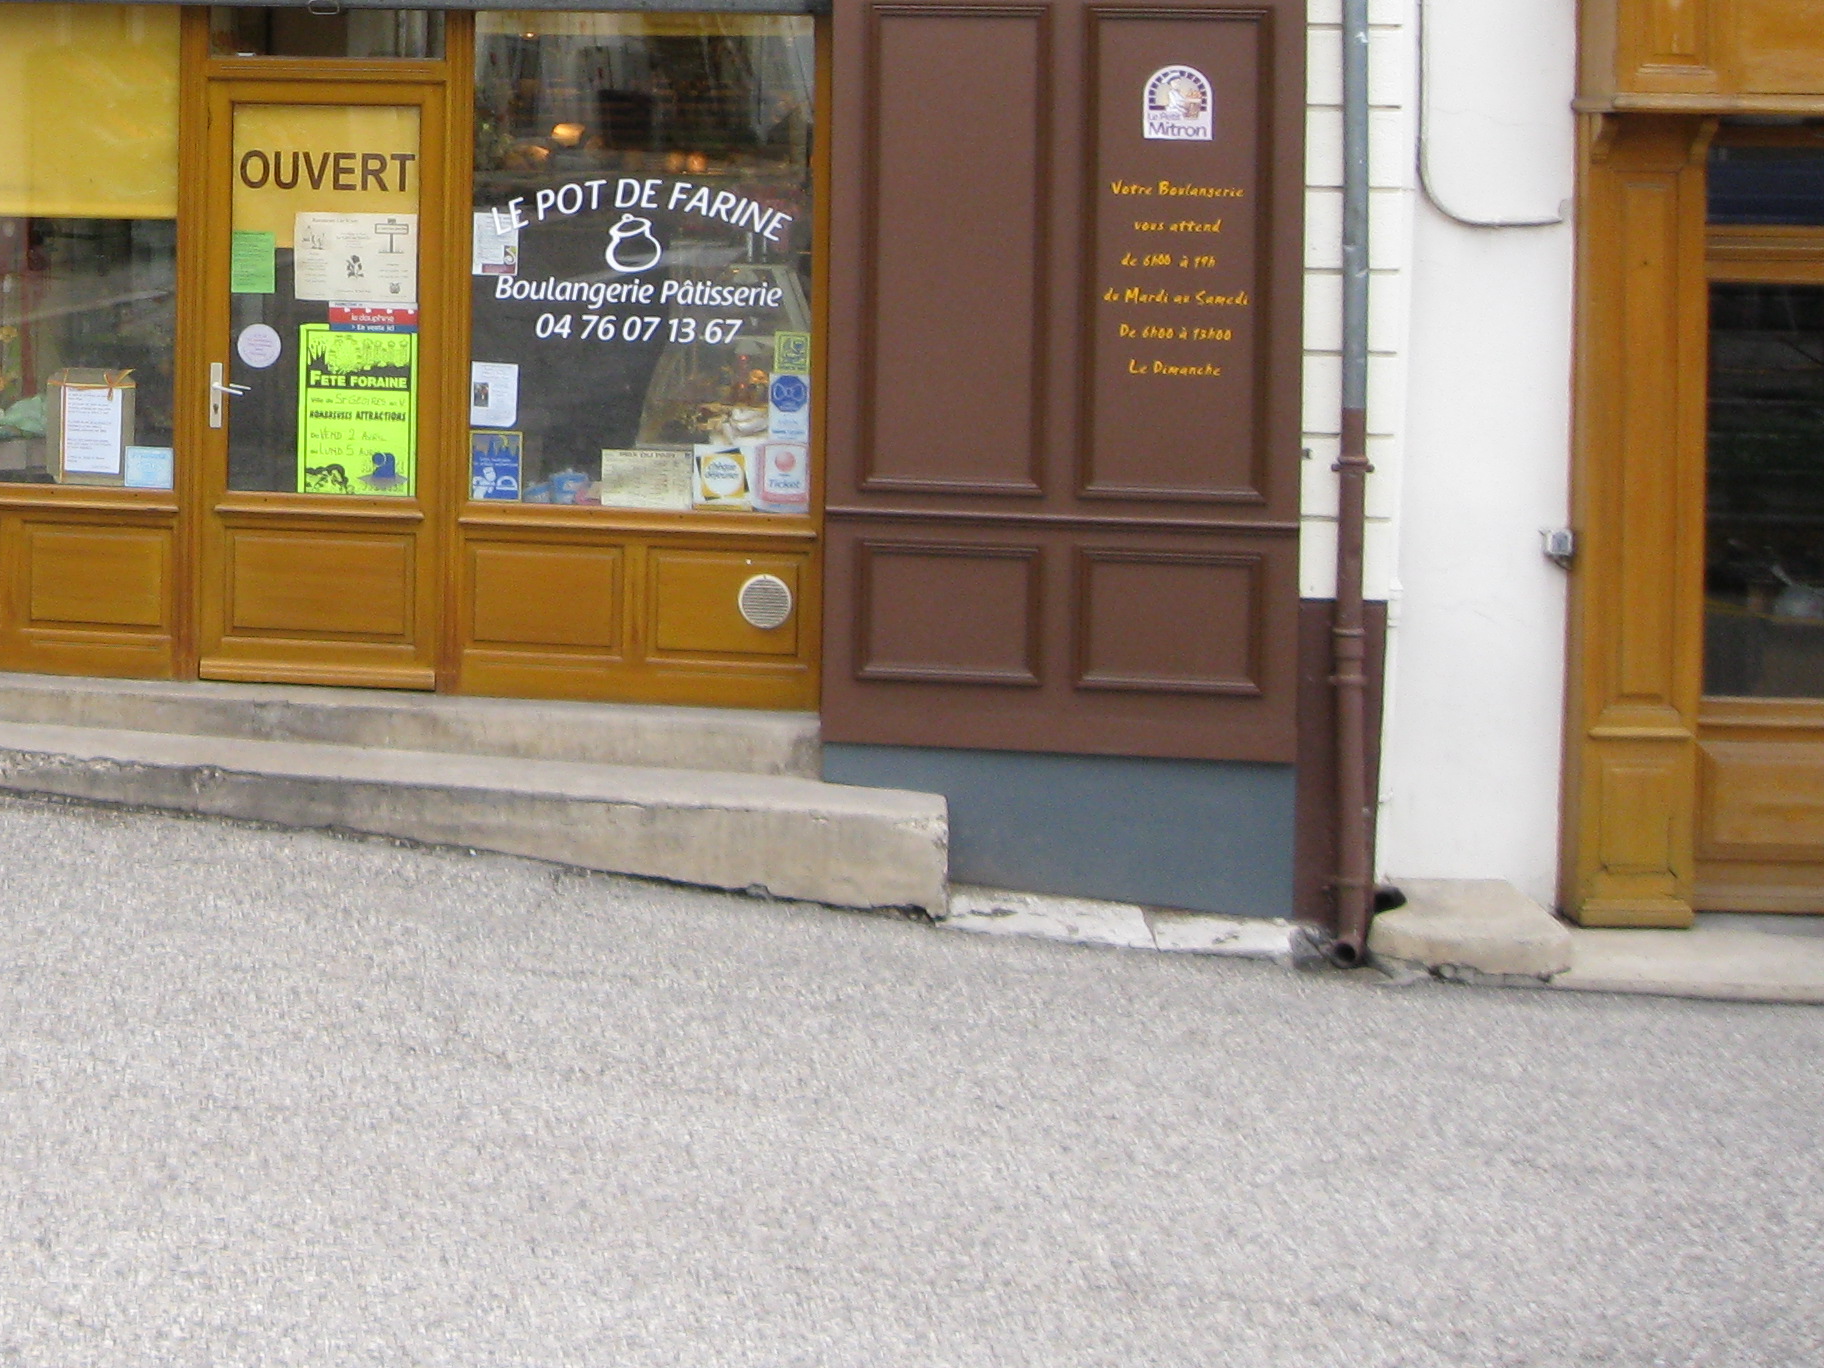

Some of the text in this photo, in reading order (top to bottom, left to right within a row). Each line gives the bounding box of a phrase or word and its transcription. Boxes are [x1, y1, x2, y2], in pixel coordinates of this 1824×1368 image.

[1148, 121, 1207, 138] Mitron
[239, 149, 416, 193] OUVERT
[1111, 179, 1245, 198] Votre Boulangerie
[491, 178, 794, 242] LE POT DE FARINE
[1134, 219, 1222, 233] vous attend
[1121, 251, 1137, 267] de
[1179, 255, 1189, 268] à
[495, 275, 783, 310] Boulangerie Pâtisserie
[1103, 286, 1250, 306] du Mardi au Samedi
[535, 312, 744, 345] 04 76 07 13 67
[1119, 323, 1137, 338] De
[1178, 327, 1188, 340] à
[1129, 359, 1222, 377] Le Dimanche
[350, 375, 408, 389] FORAINE
[355, 411, 406, 422] ATTRACTIONS
